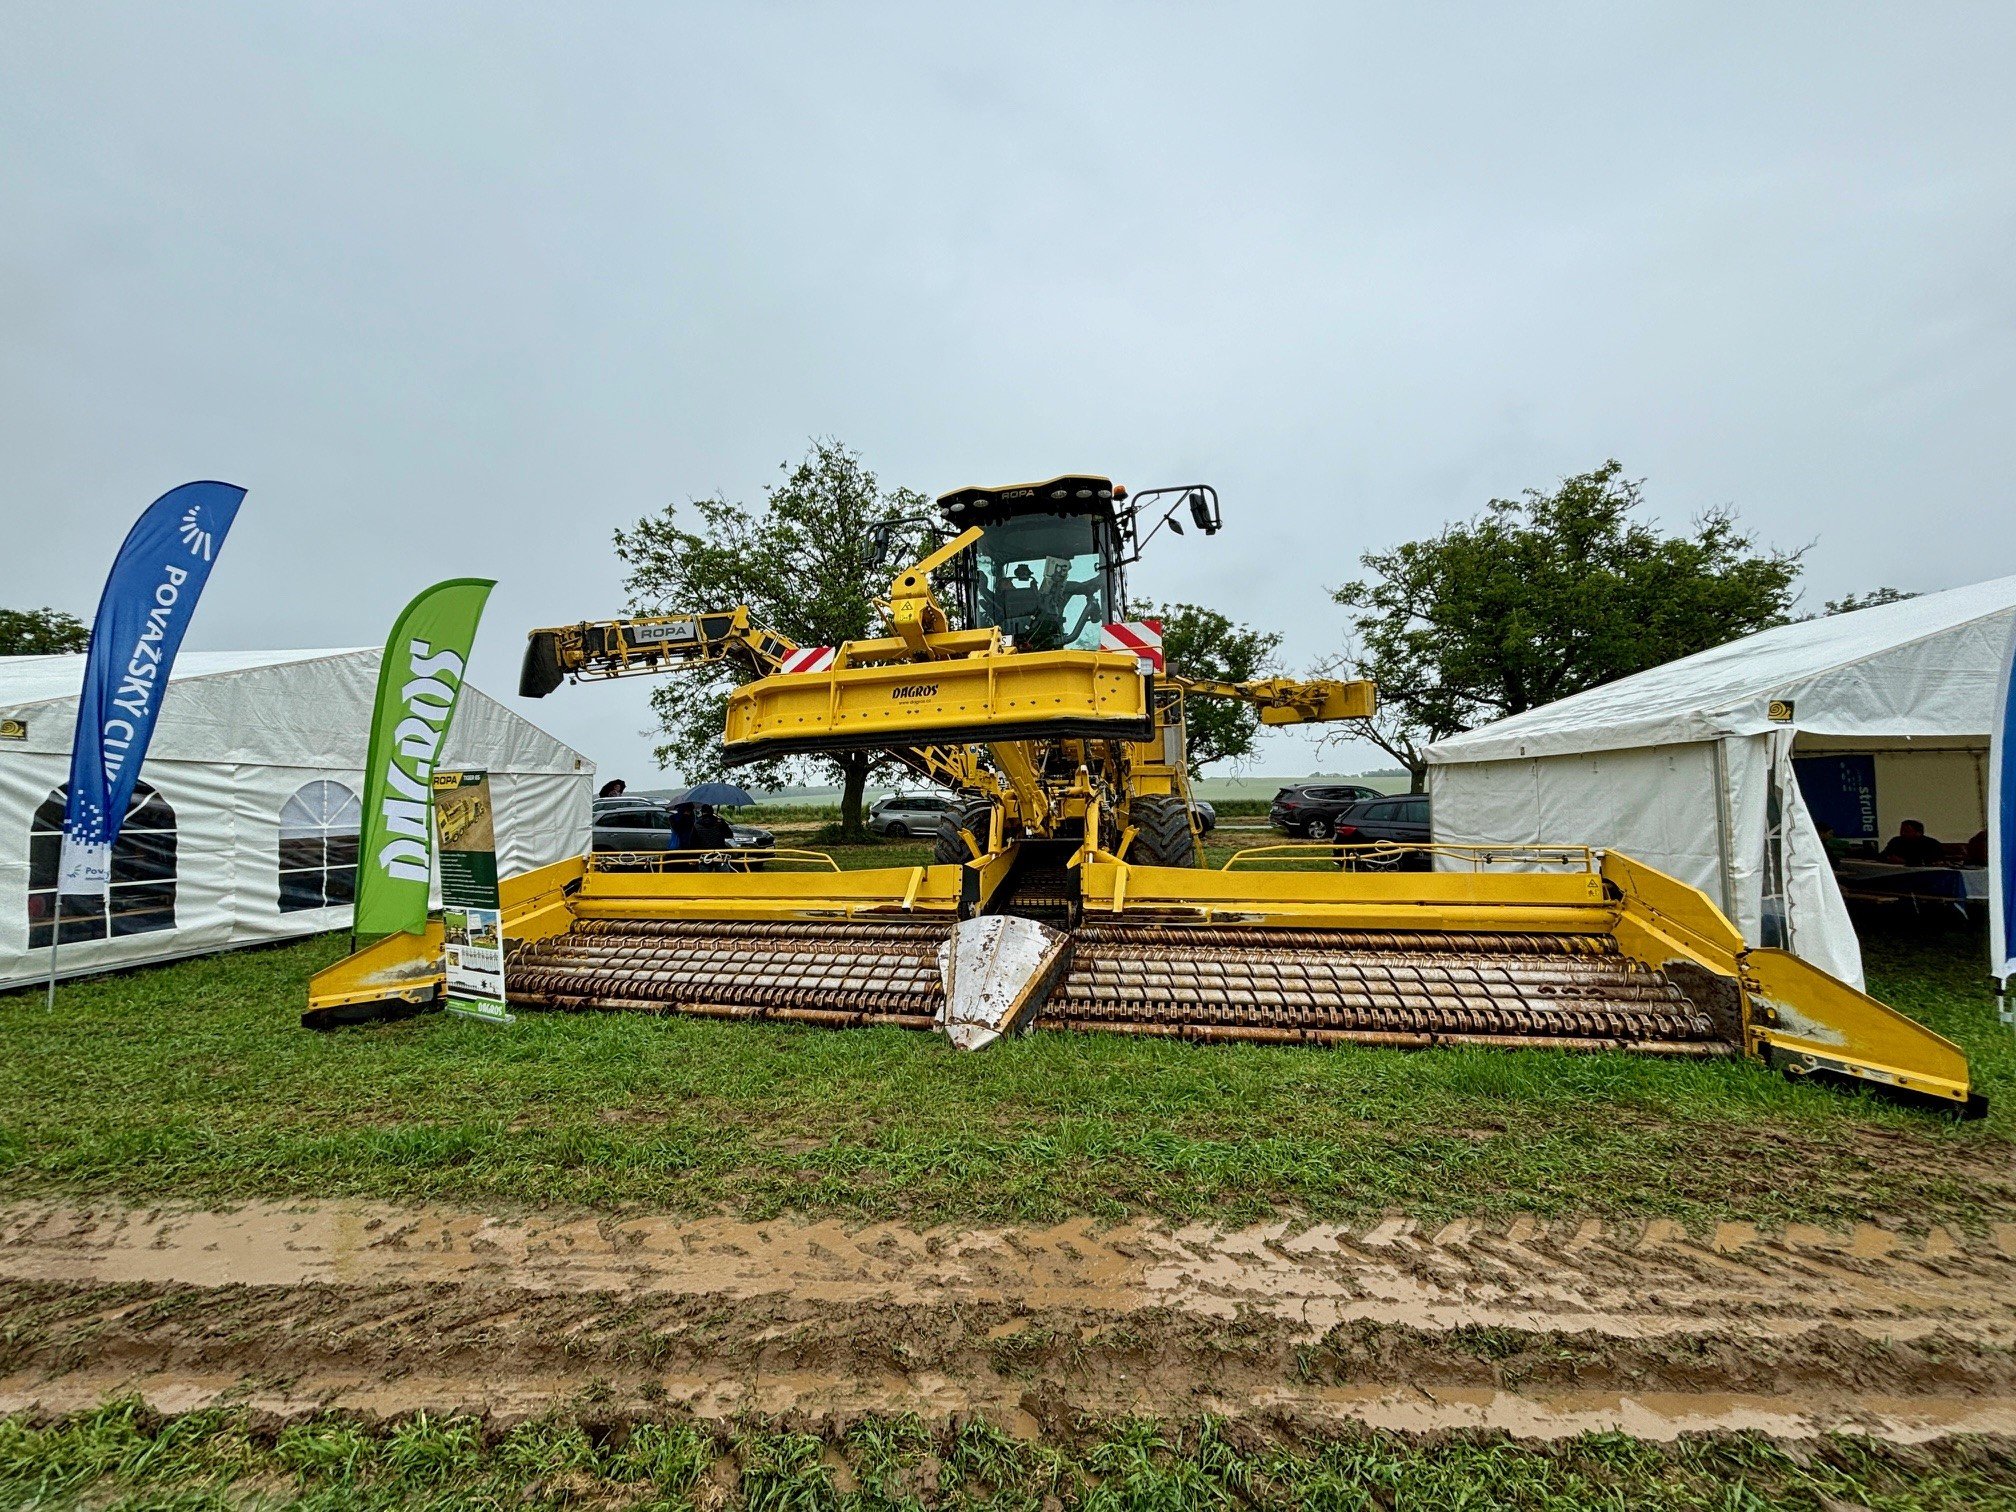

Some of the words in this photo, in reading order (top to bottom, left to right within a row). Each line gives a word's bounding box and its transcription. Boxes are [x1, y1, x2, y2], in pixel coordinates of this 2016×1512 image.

[1001, 489, 1035, 500] ROPA
[640, 626, 688, 639] ROPA
[113, 565, 187, 718] POVAŽSKÝ
[892, 684, 939, 699] DAGROS
[378, 638, 465, 882] DAGROS
[433, 776, 458, 785] ROPA
[1858, 786, 1876, 832] strube
[478, 1002, 503, 1016] DAGROS
